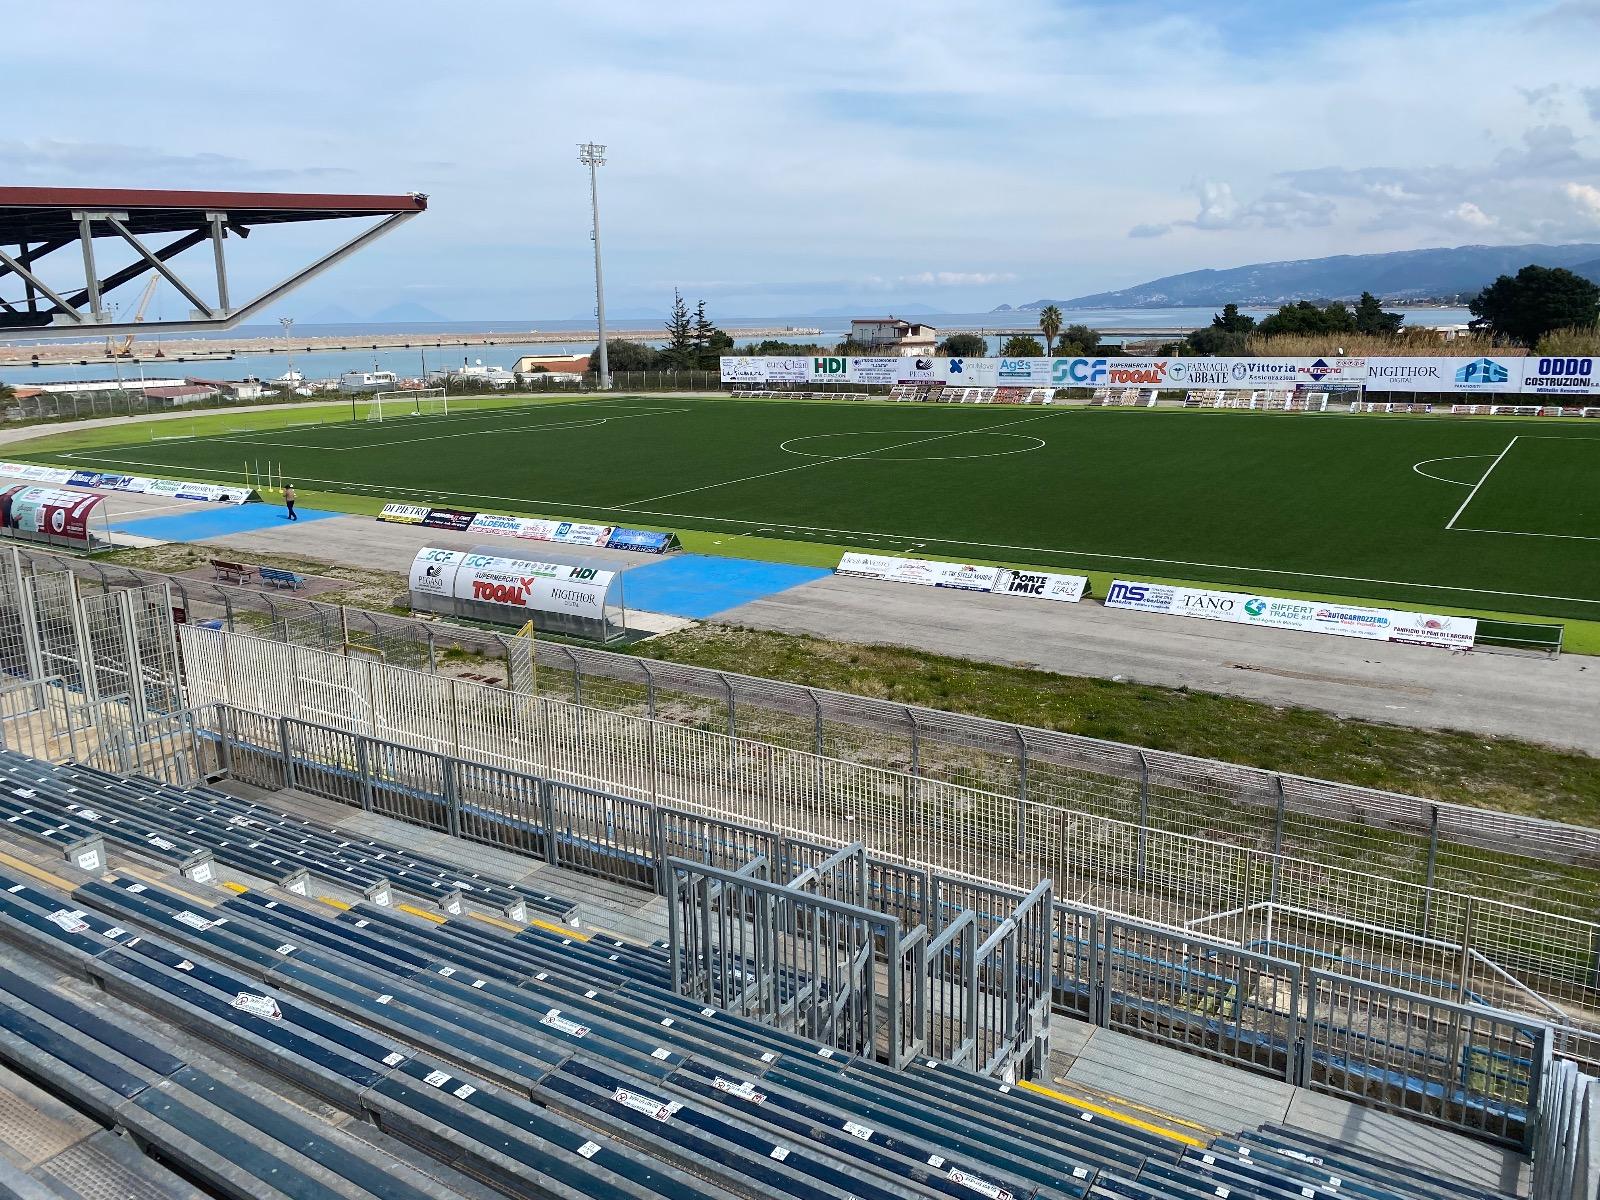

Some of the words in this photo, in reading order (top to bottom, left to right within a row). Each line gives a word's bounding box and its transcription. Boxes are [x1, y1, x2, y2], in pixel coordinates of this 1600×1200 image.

[815, 358, 846, 373] HDI
[1000, 359, 1031, 371] Agos
[1052, 359, 1106, 382] SCF
[1187, 363, 1228, 371] FARMACIA
[1247, 364, 1296, 373] Vittoria
[1539, 358, 1593, 375] ODDO
[1187, 372, 1229, 383] ABBATE
[1369, 366, 1440, 378] NIGITHOR
[1525, 377, 1590, 387] COSTRUZIONI
[384, 504, 395, 512] DI
[395, 505, 430, 516] PIETRO
[473, 519, 522, 530] CALDERONE
[426, 550, 453, 562] SCF
[475, 572, 519, 583] SUPERMERCATI
[569, 567, 598, 580] HDI
[1012, 572, 1048, 584] PORTE
[1008, 582, 1045, 595] IMIC
[1052, 585, 1077, 593] ITALY
[551, 589, 597, 606] NIGITHOR
[1184, 594, 1234, 611] TANO
[1270, 603, 1315, 614] SIFFERT
[1269, 610, 1300, 620] TRADE
[1327, 612, 1388, 624] AUTOCARROZZERIA
